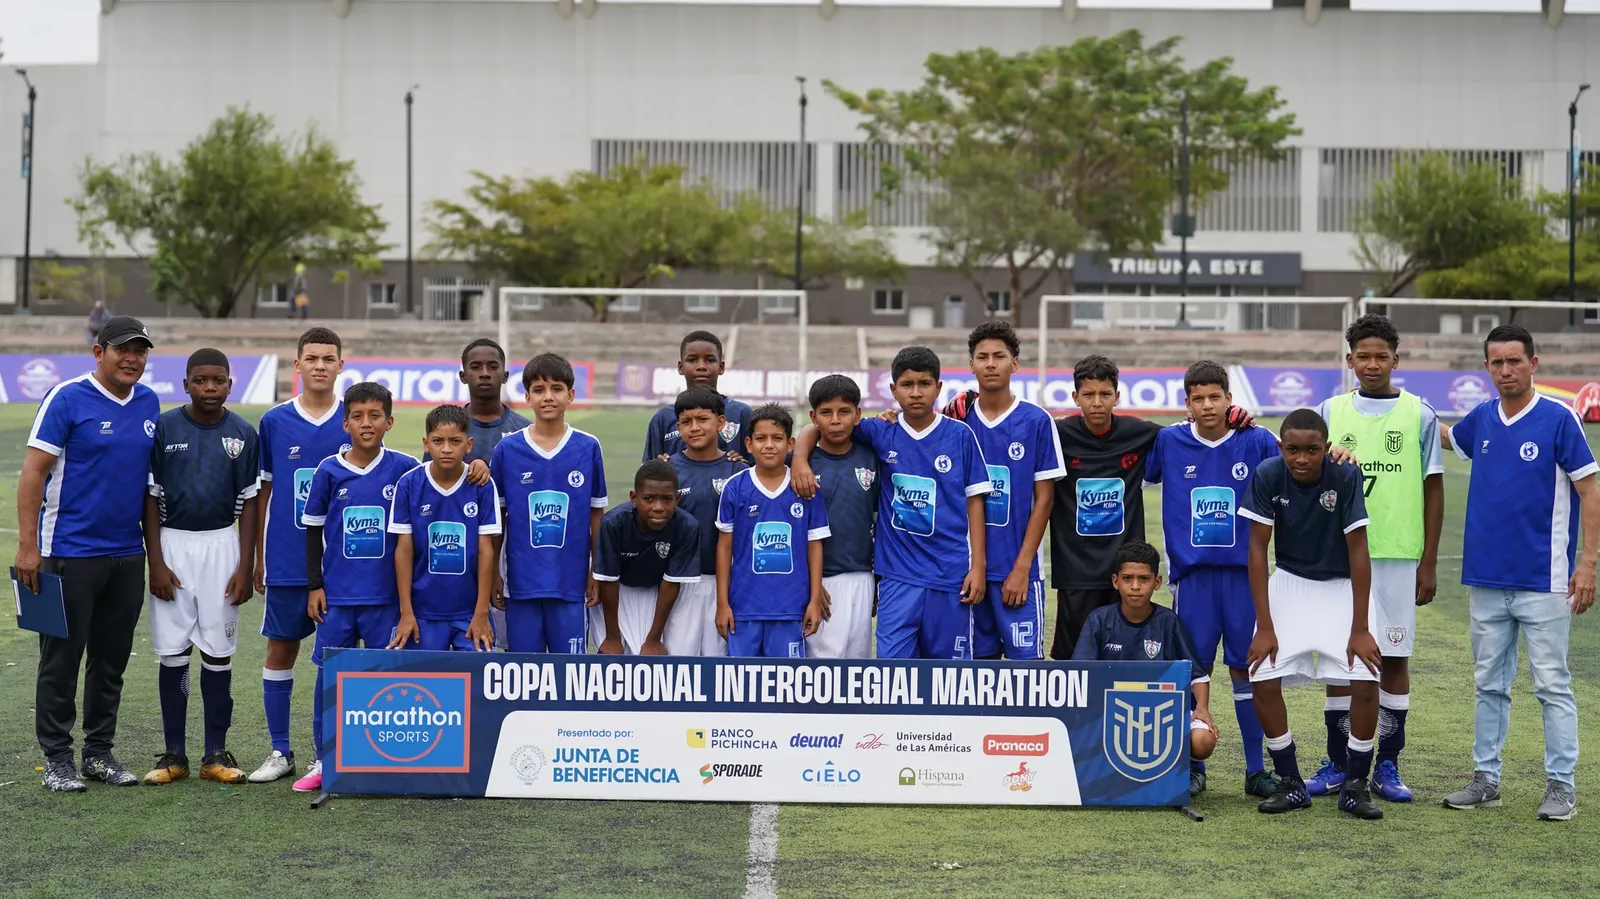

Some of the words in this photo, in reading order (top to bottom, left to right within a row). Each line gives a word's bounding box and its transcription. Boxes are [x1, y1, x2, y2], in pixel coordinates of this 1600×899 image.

[1209, 259, 1264, 276] ESTE
[1360, 461, 1402, 473] rathon
[1080, 489, 1119, 504] Kyma
[534, 502, 562, 517] Kyma
[1196, 499, 1230, 515] Kyma
[346, 516, 380, 530] Kyma
[432, 532, 460, 545] Kyma
[756, 532, 788, 547] Kyma
[1010, 621, 1034, 648] 12
[952, 635, 967, 660] 5
[483, 661, 558, 701] COPA
[565, 663, 707, 702] NACIONAL
[715, 664, 924, 705] INTERCOLEGIAL
[931, 667, 1089, 708] MARATHON
[345, 706, 461, 726] marathon
[378, 731, 429, 742] SPORTS
[557, 728, 612, 738] Presentado
[614, 730, 634, 739] por:
[711, 728, 754, 738] BANCO
[789, 733, 844, 748] deuna!
[896, 731, 952, 741] Universidad
[711, 739, 778, 749] PICHINCHA
[896, 743, 908, 752] de
[910, 743, 926, 752] Las
[930, 743, 972, 753] Américas
[552, 748, 612, 764] JUNTA
[616, 748, 639, 763] DE
[553, 767, 680, 783] BENEFICENCIA
[712, 763, 763, 778] SPORADE
[918, 768, 965, 782] Hispana
